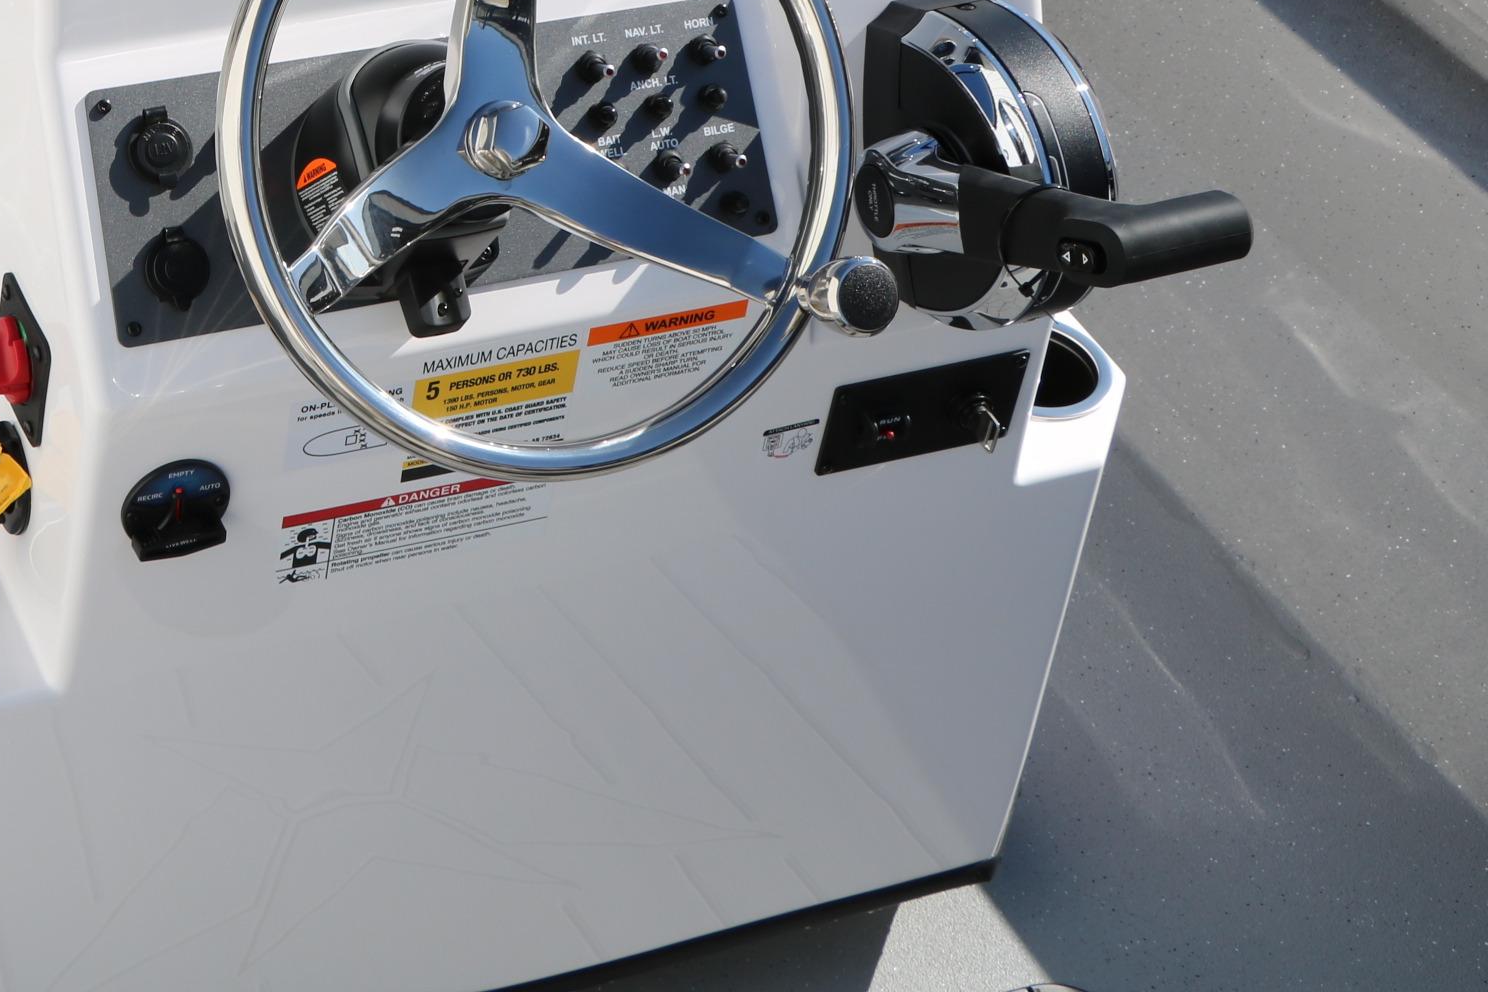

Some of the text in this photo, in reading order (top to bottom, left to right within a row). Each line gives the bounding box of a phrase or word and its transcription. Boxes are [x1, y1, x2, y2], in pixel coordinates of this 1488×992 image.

[684, 16, 715, 30] HORN
[625, 24, 664, 38] NAV. LT.
[571, 32, 607, 46] INT. LT.
[630, 75, 678, 91] ANCH. LT.
[703, 123, 735, 137] BILGE
[597, 134, 621, 147] BAIT
[650, 138, 679, 151] AUTO
[663, 184, 687, 198] MAN
[645, 310, 716, 332] WARNING
[423, 334, 578, 374] MAXIMUM CAPACITIES
[426, 362, 560, 401] 5 PERSONS OR 730 LBS.
[537, 378, 555, 387] GEAR
[474, 397, 498, 407] MOTOR
[168, 469, 195, 479] EMPTY
[199, 482, 221, 491] AUTO
[137, 492, 163, 502] RECIRC
[399, 484, 461, 504] DANGER
